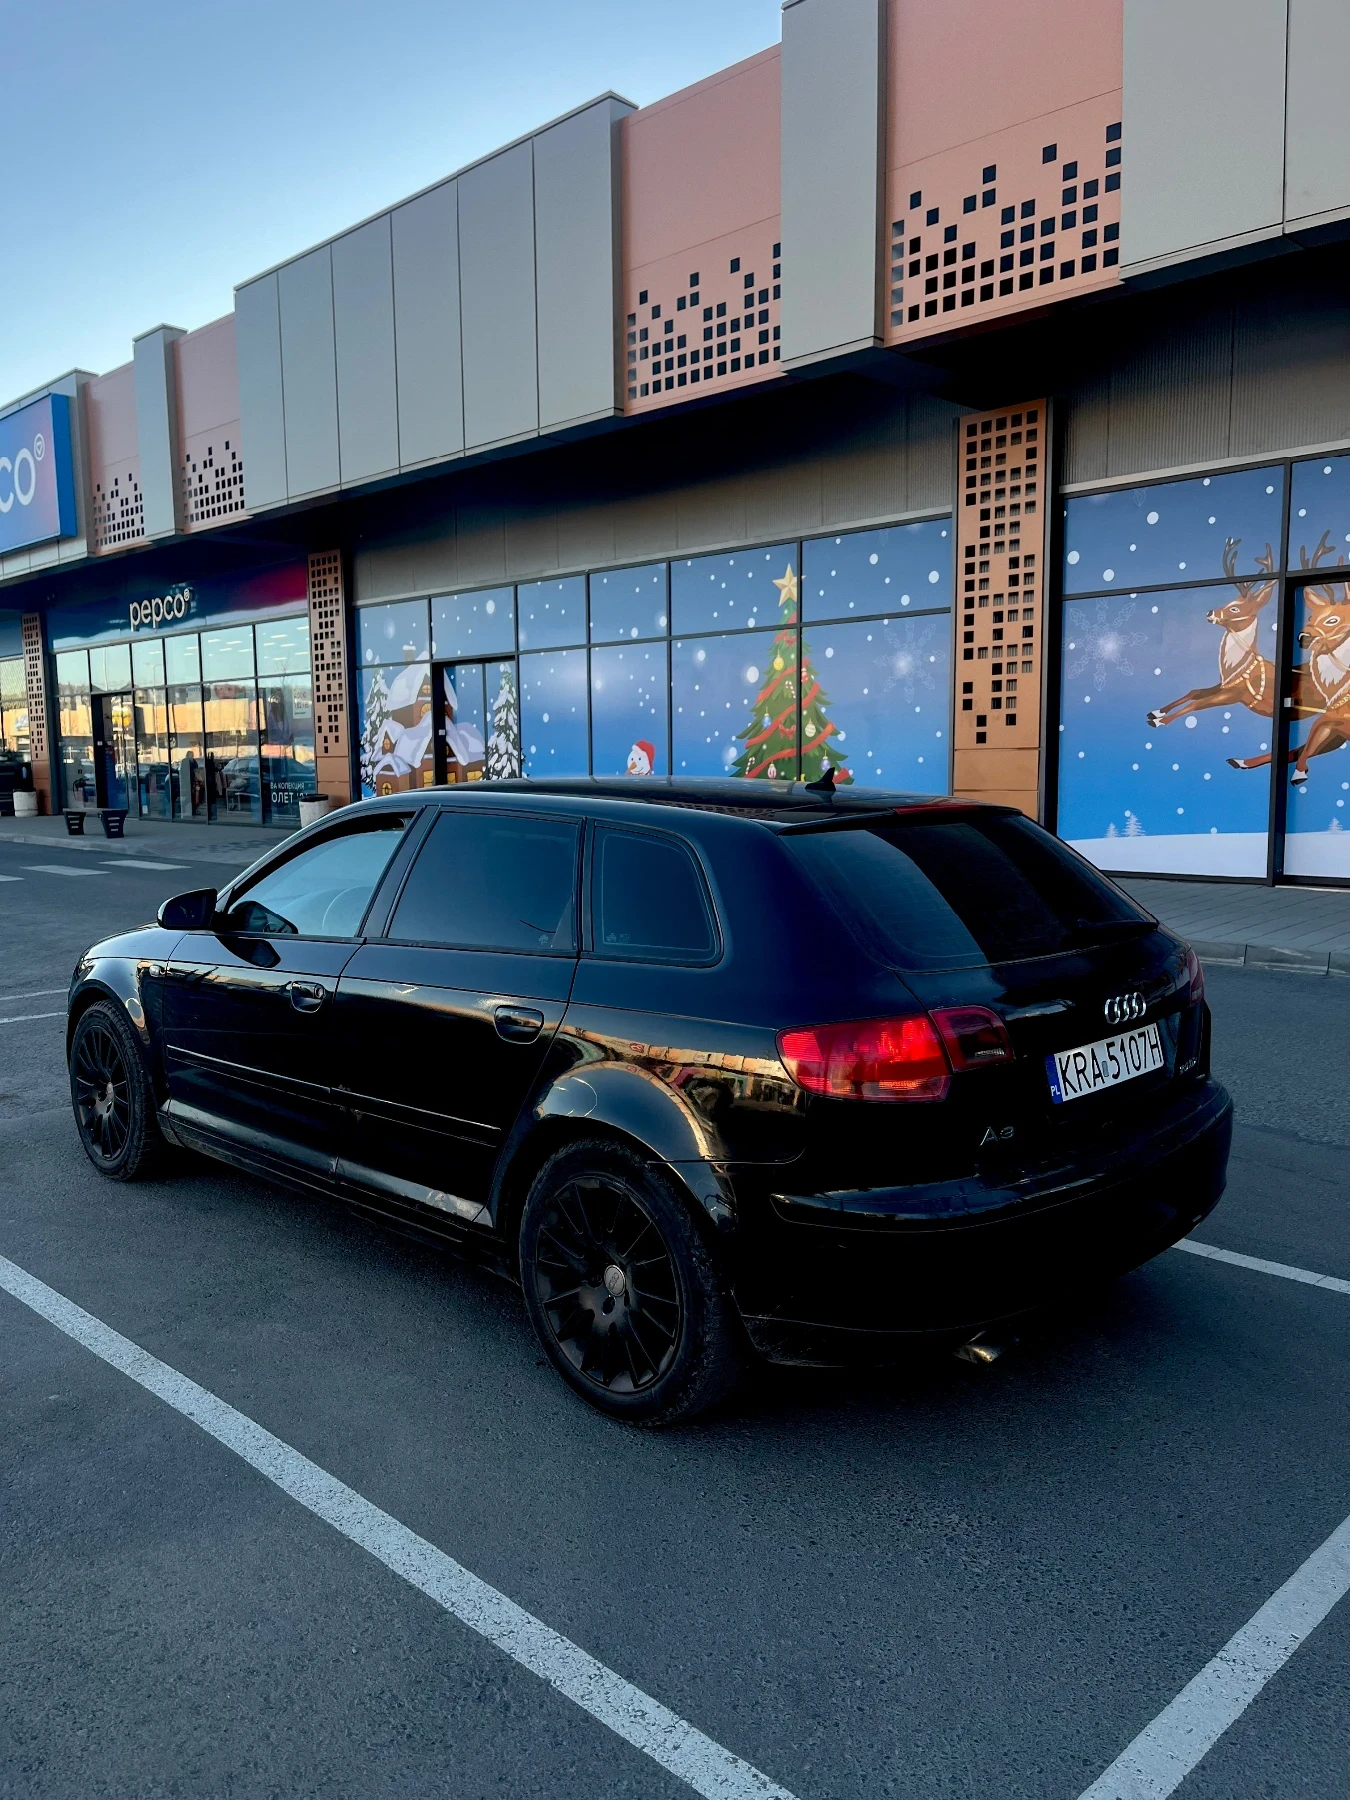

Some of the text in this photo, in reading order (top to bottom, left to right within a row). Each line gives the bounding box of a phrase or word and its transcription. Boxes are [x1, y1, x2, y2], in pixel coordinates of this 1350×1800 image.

[129, 593, 185, 632] pepco
[1058, 1027, 1163, 1096] KRA 5107H
[1050, 1085, 1061, 1097] PL
[979, 1125, 1016, 1147] A3
